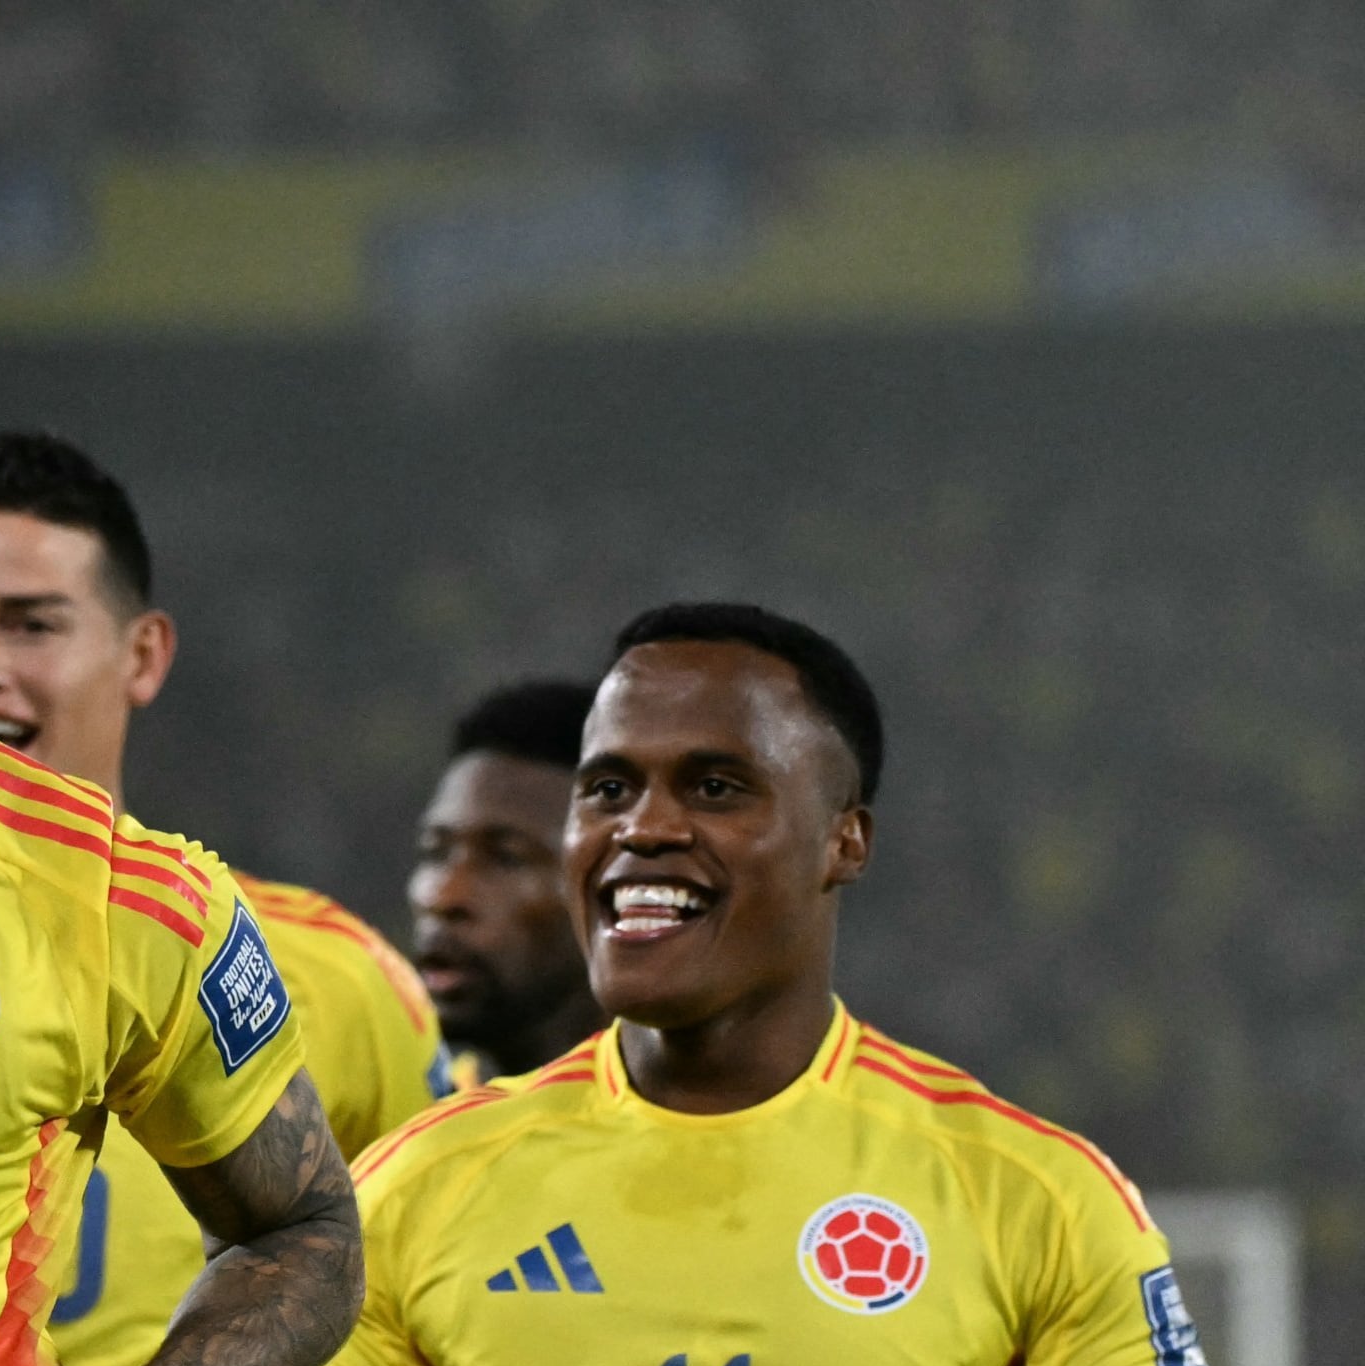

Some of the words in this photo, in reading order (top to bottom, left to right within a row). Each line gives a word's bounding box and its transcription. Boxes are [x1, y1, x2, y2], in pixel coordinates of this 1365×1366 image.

[219, 934, 254, 994] FOOTBALL
[227, 946, 264, 1009] UNITES
[229, 1004, 252, 1030] the
[249, 960, 274, 1010] World
[252, 1001, 273, 1026] FIFA
